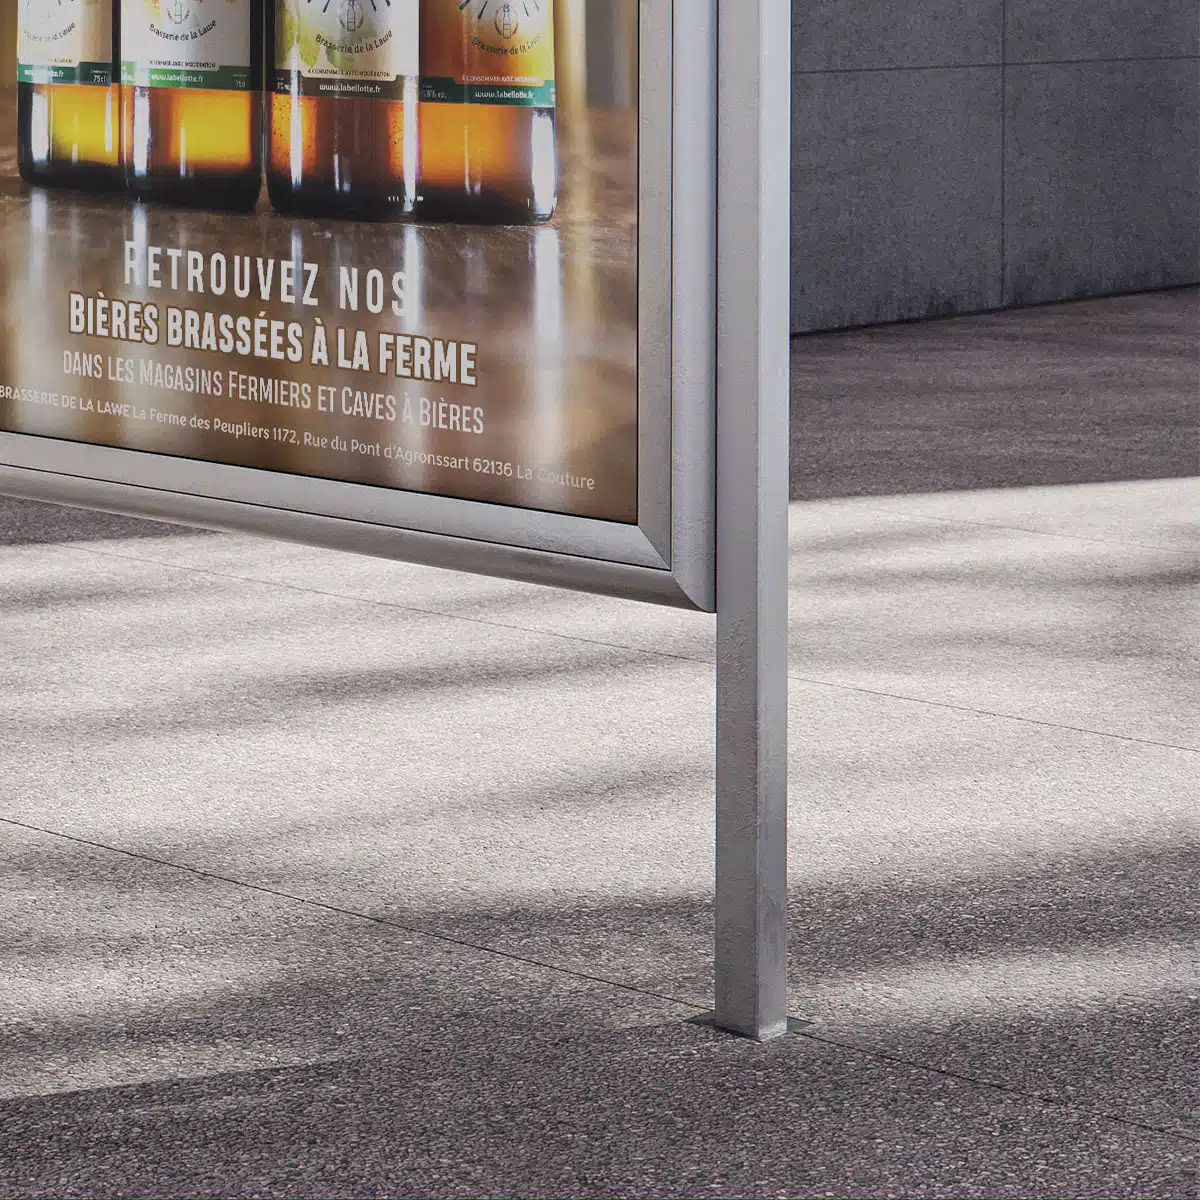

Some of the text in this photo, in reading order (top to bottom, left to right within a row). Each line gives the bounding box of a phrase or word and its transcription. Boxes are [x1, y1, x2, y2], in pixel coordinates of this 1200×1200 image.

[316, 34, 353, 54] Brasserie
[354, 44, 364, 54] de
[365, 40, 374, 52] la
[319, 83, 382, 94] www.labellotte.fr
[124, 240, 407, 317] RETROUVEZ NOS
[70, 290, 478, 386] BIÈRES BRASSÉES À LA FERME
[64, 350, 484, 434] DANS LES MAGASINS FERMIERS ET CAVES À BIÈRES
[61, 396, 77, 410] DE
[79, 397, 94, 412] LA
[97, 400, 130, 418] LAWE
[132, 404, 147, 420] La
[150, 408, 187, 427] Ferme
[189, 414, 210, 430] des
[214, 417, 270, 440] Peupliers
[272, 426, 300, 446] 1172,
[304, 432, 328, 450] Rue
[331, 435, 348, 452] du
[351, 438, 381, 458] Pont
[384, 444, 470, 473] d'Agronssart
[472, 458, 513, 478] 62136
[516, 464, 533, 482] La
